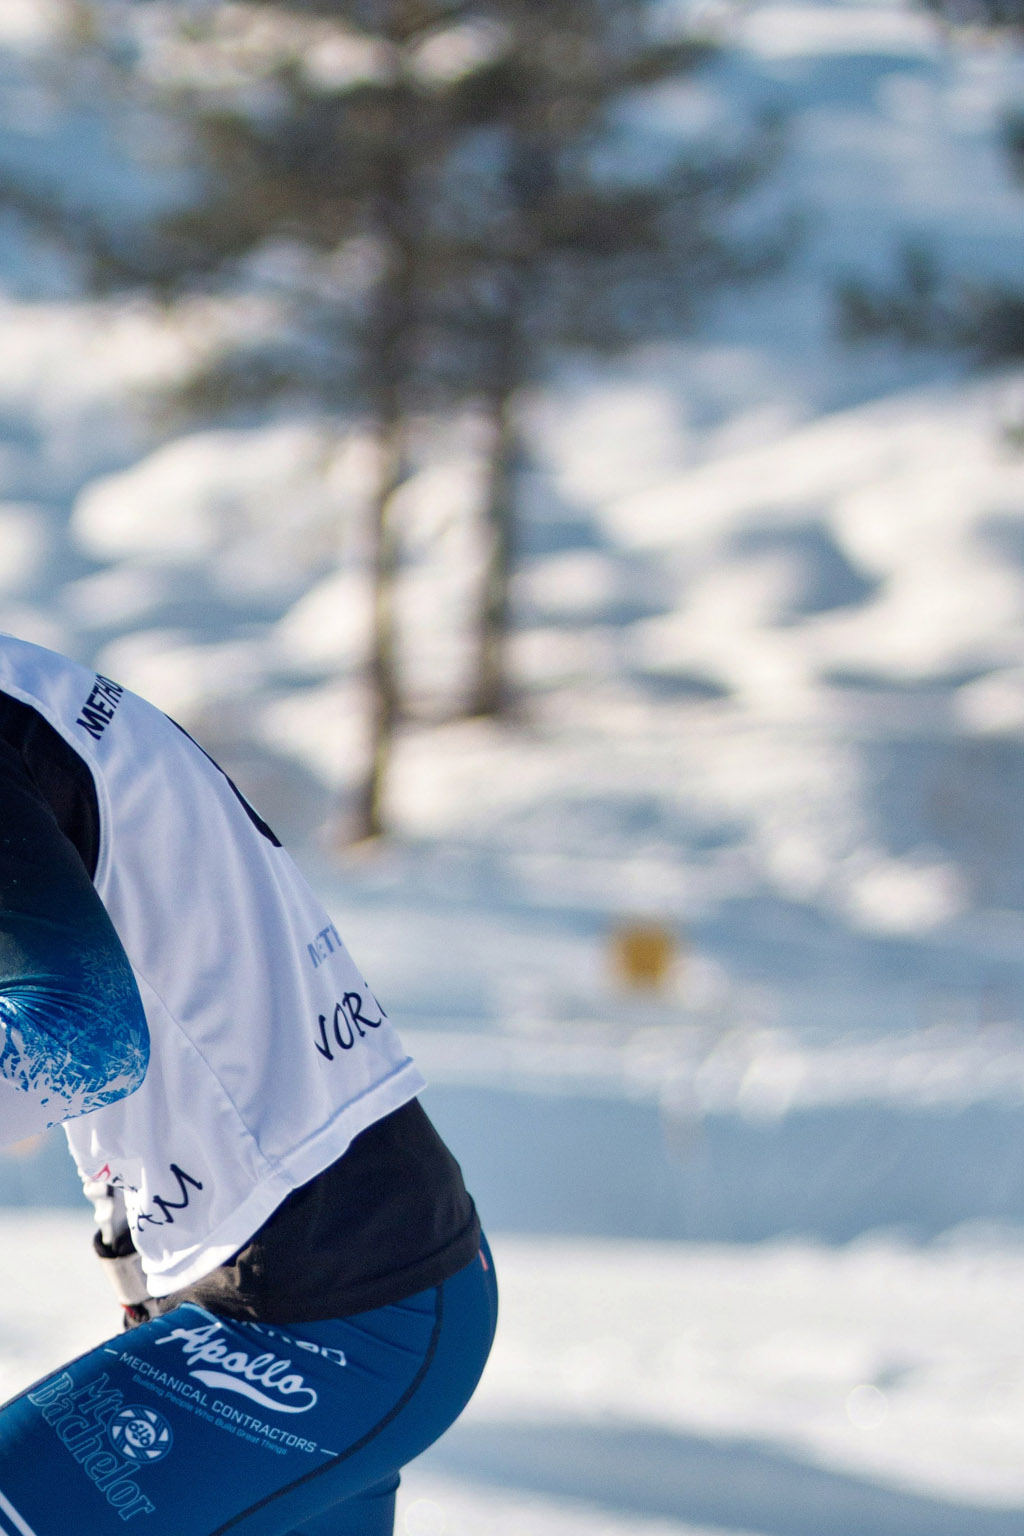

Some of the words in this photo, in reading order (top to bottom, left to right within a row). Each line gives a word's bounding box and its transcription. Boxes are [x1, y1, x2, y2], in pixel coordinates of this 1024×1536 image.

[119, 1352, 208, 1406] MECHANICAL
[211, 1400, 317, 1453] CONTRACTORS
[155, 1322, 317, 1413] Apollo
[27, 1372, 156, 1521] Bachelor
